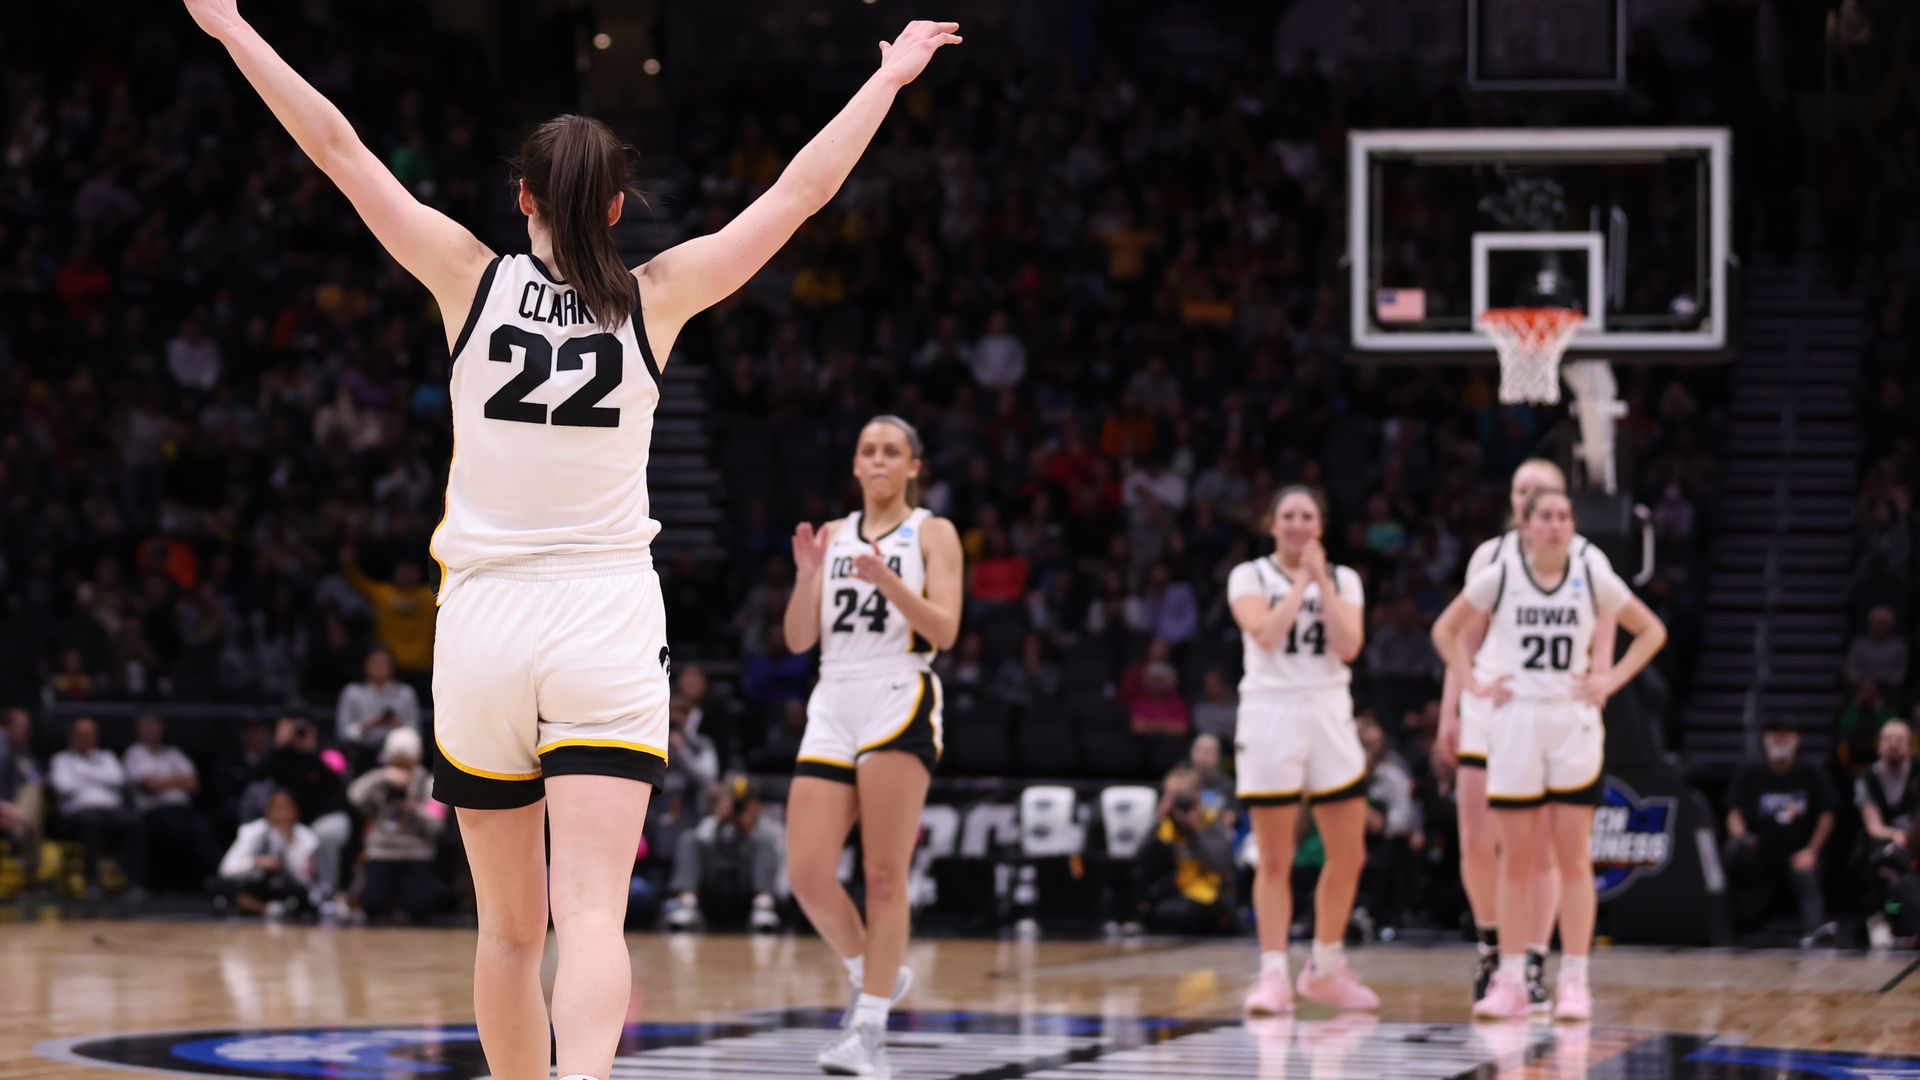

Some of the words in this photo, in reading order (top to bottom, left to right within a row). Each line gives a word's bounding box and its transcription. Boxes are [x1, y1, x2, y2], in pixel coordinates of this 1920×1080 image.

[519, 281, 595, 326] CLARK
[484, 324, 623, 427] 22
[831, 555, 902, 580] IOA
[832, 587, 889, 633] 24
[1516, 606, 1580, 626] IOWA
[1286, 620, 1326, 655] 14
[1521, 635, 1573, 670] 20
